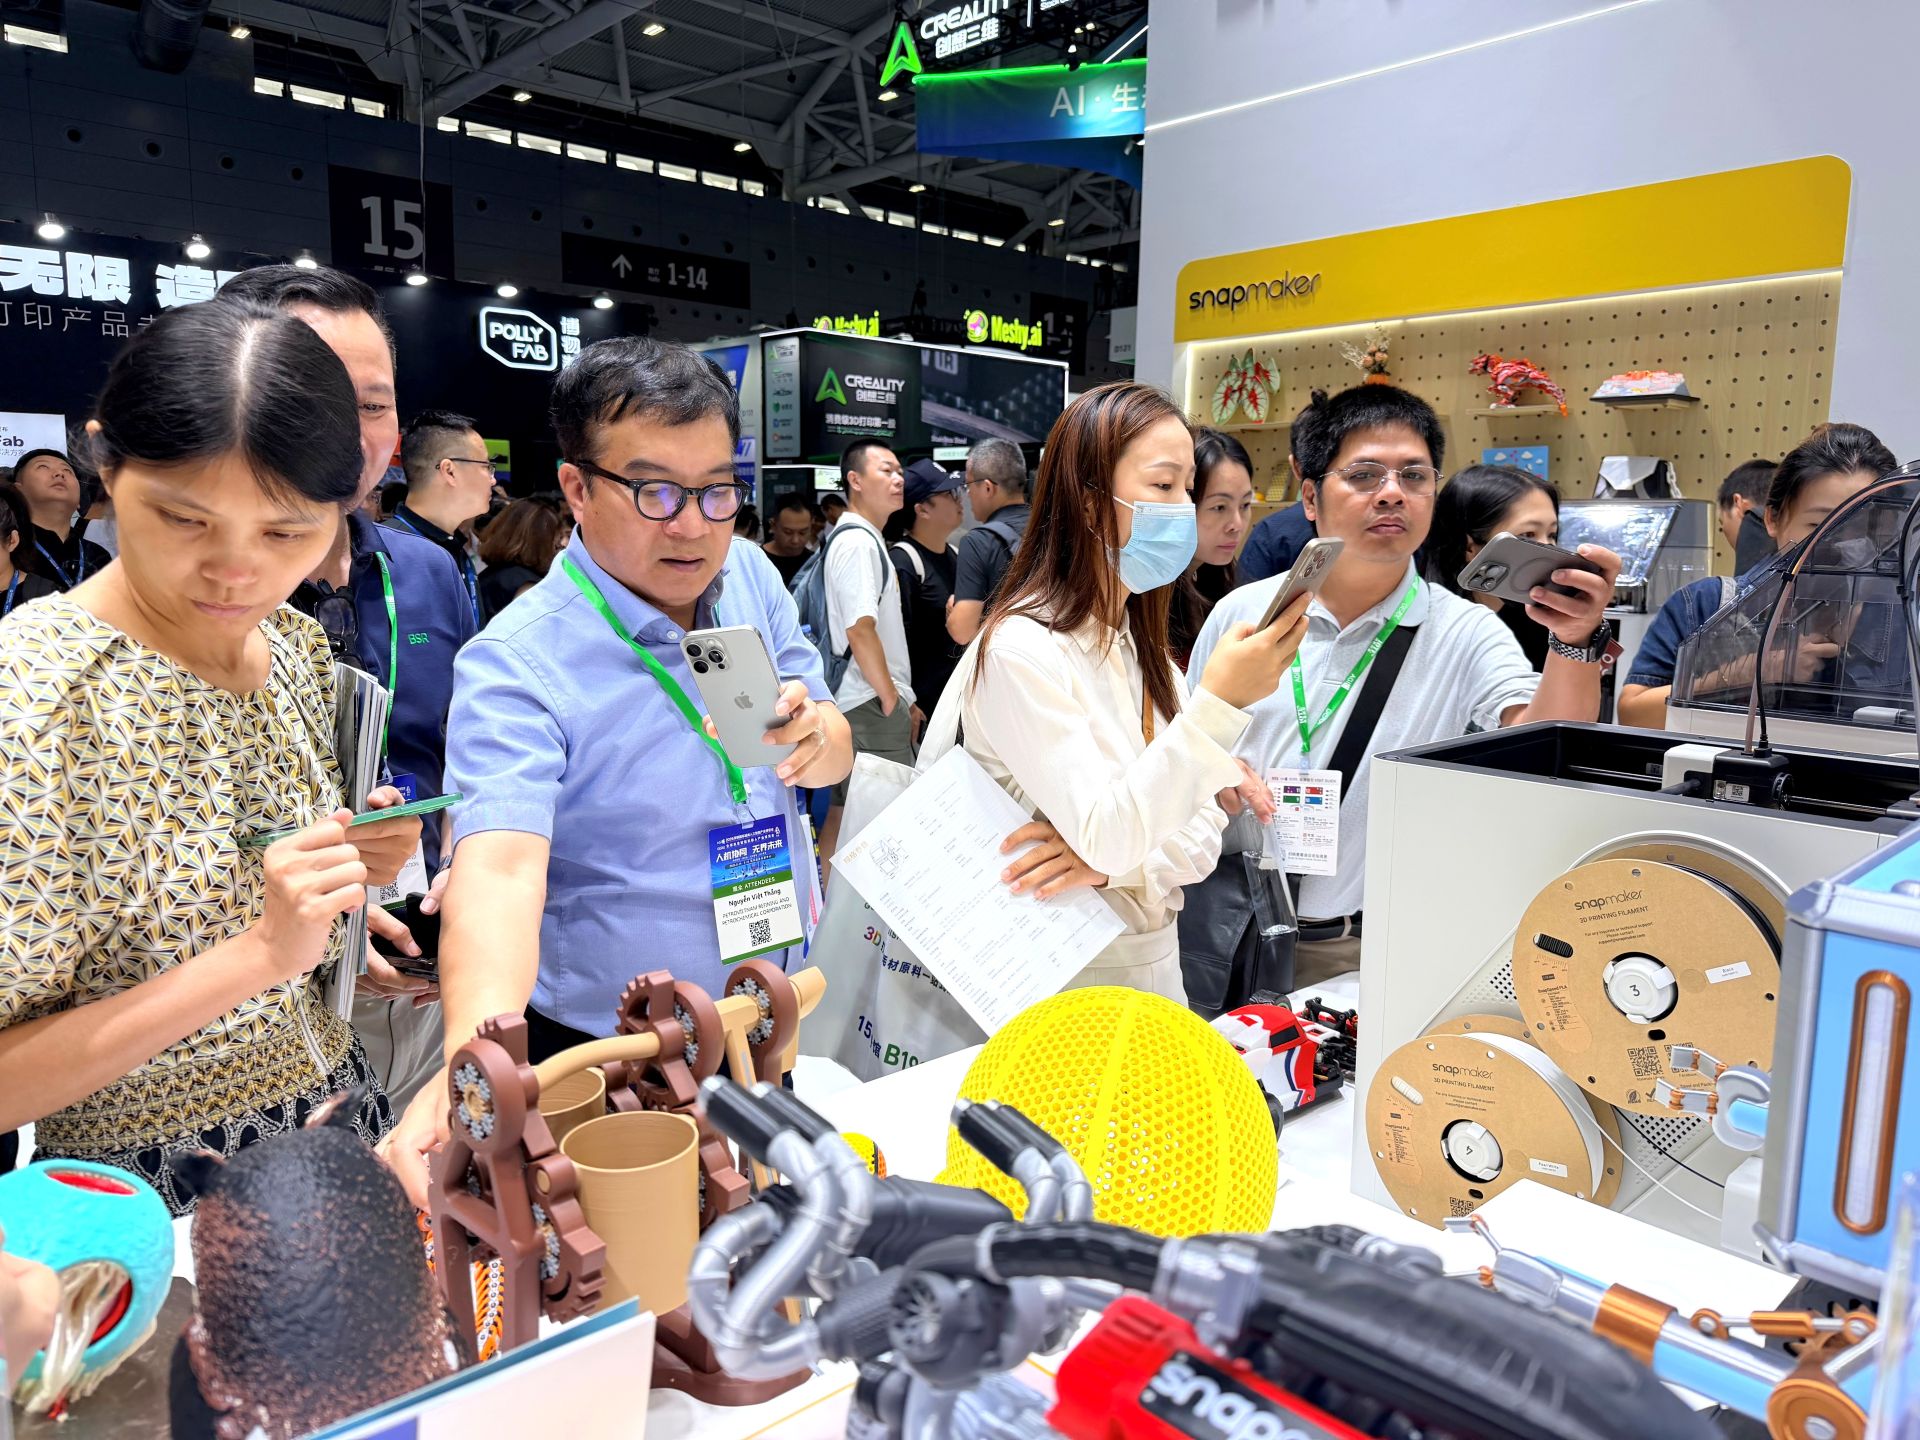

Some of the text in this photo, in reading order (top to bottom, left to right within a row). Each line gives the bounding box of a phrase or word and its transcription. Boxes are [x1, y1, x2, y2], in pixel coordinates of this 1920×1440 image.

[935, 17, 1000, 59] 创想三维
[1050, 85, 1086, 118] AI
[1110, 81, 1145, 113] 生
[361, 196, 424, 259] 15
[0, 244, 244, 308] 无限 造
[668, 262, 708, 290] 1-14
[1189, 270, 1321, 311] snapmaker
[489, 321, 544, 342] POLLY
[991, 315, 1042, 350] Meshy.ai
[512, 342, 549, 361] FAB
[844, 374, 906, 393] CREALITY
[0, 435, 25, 447] ab
[408, 632, 430, 645] BSR
[752, 839, 784, 854] 无界未来
[744, 877, 776, 889] ATTENDEES
[779, 896, 790, 904] AND
[1574, 890, 1643, 911] snapmaker
[722, 904, 793, 925] PETROCHEMICAL CORPORATION
[1588, 912, 1618, 921] PRINTING
[1617, 906, 1649, 916] FILAMENT
[1629, 984, 1641, 997] 3
[1432, 1063, 1494, 1079] snapmaker
[1441, 1078, 1467, 1087] PRINTING
[1467, 1082, 1495, 1091] FILAMENT
[1466, 1145, 1474, 1155] 4
[1150, 1360, 1312, 1440] snap
